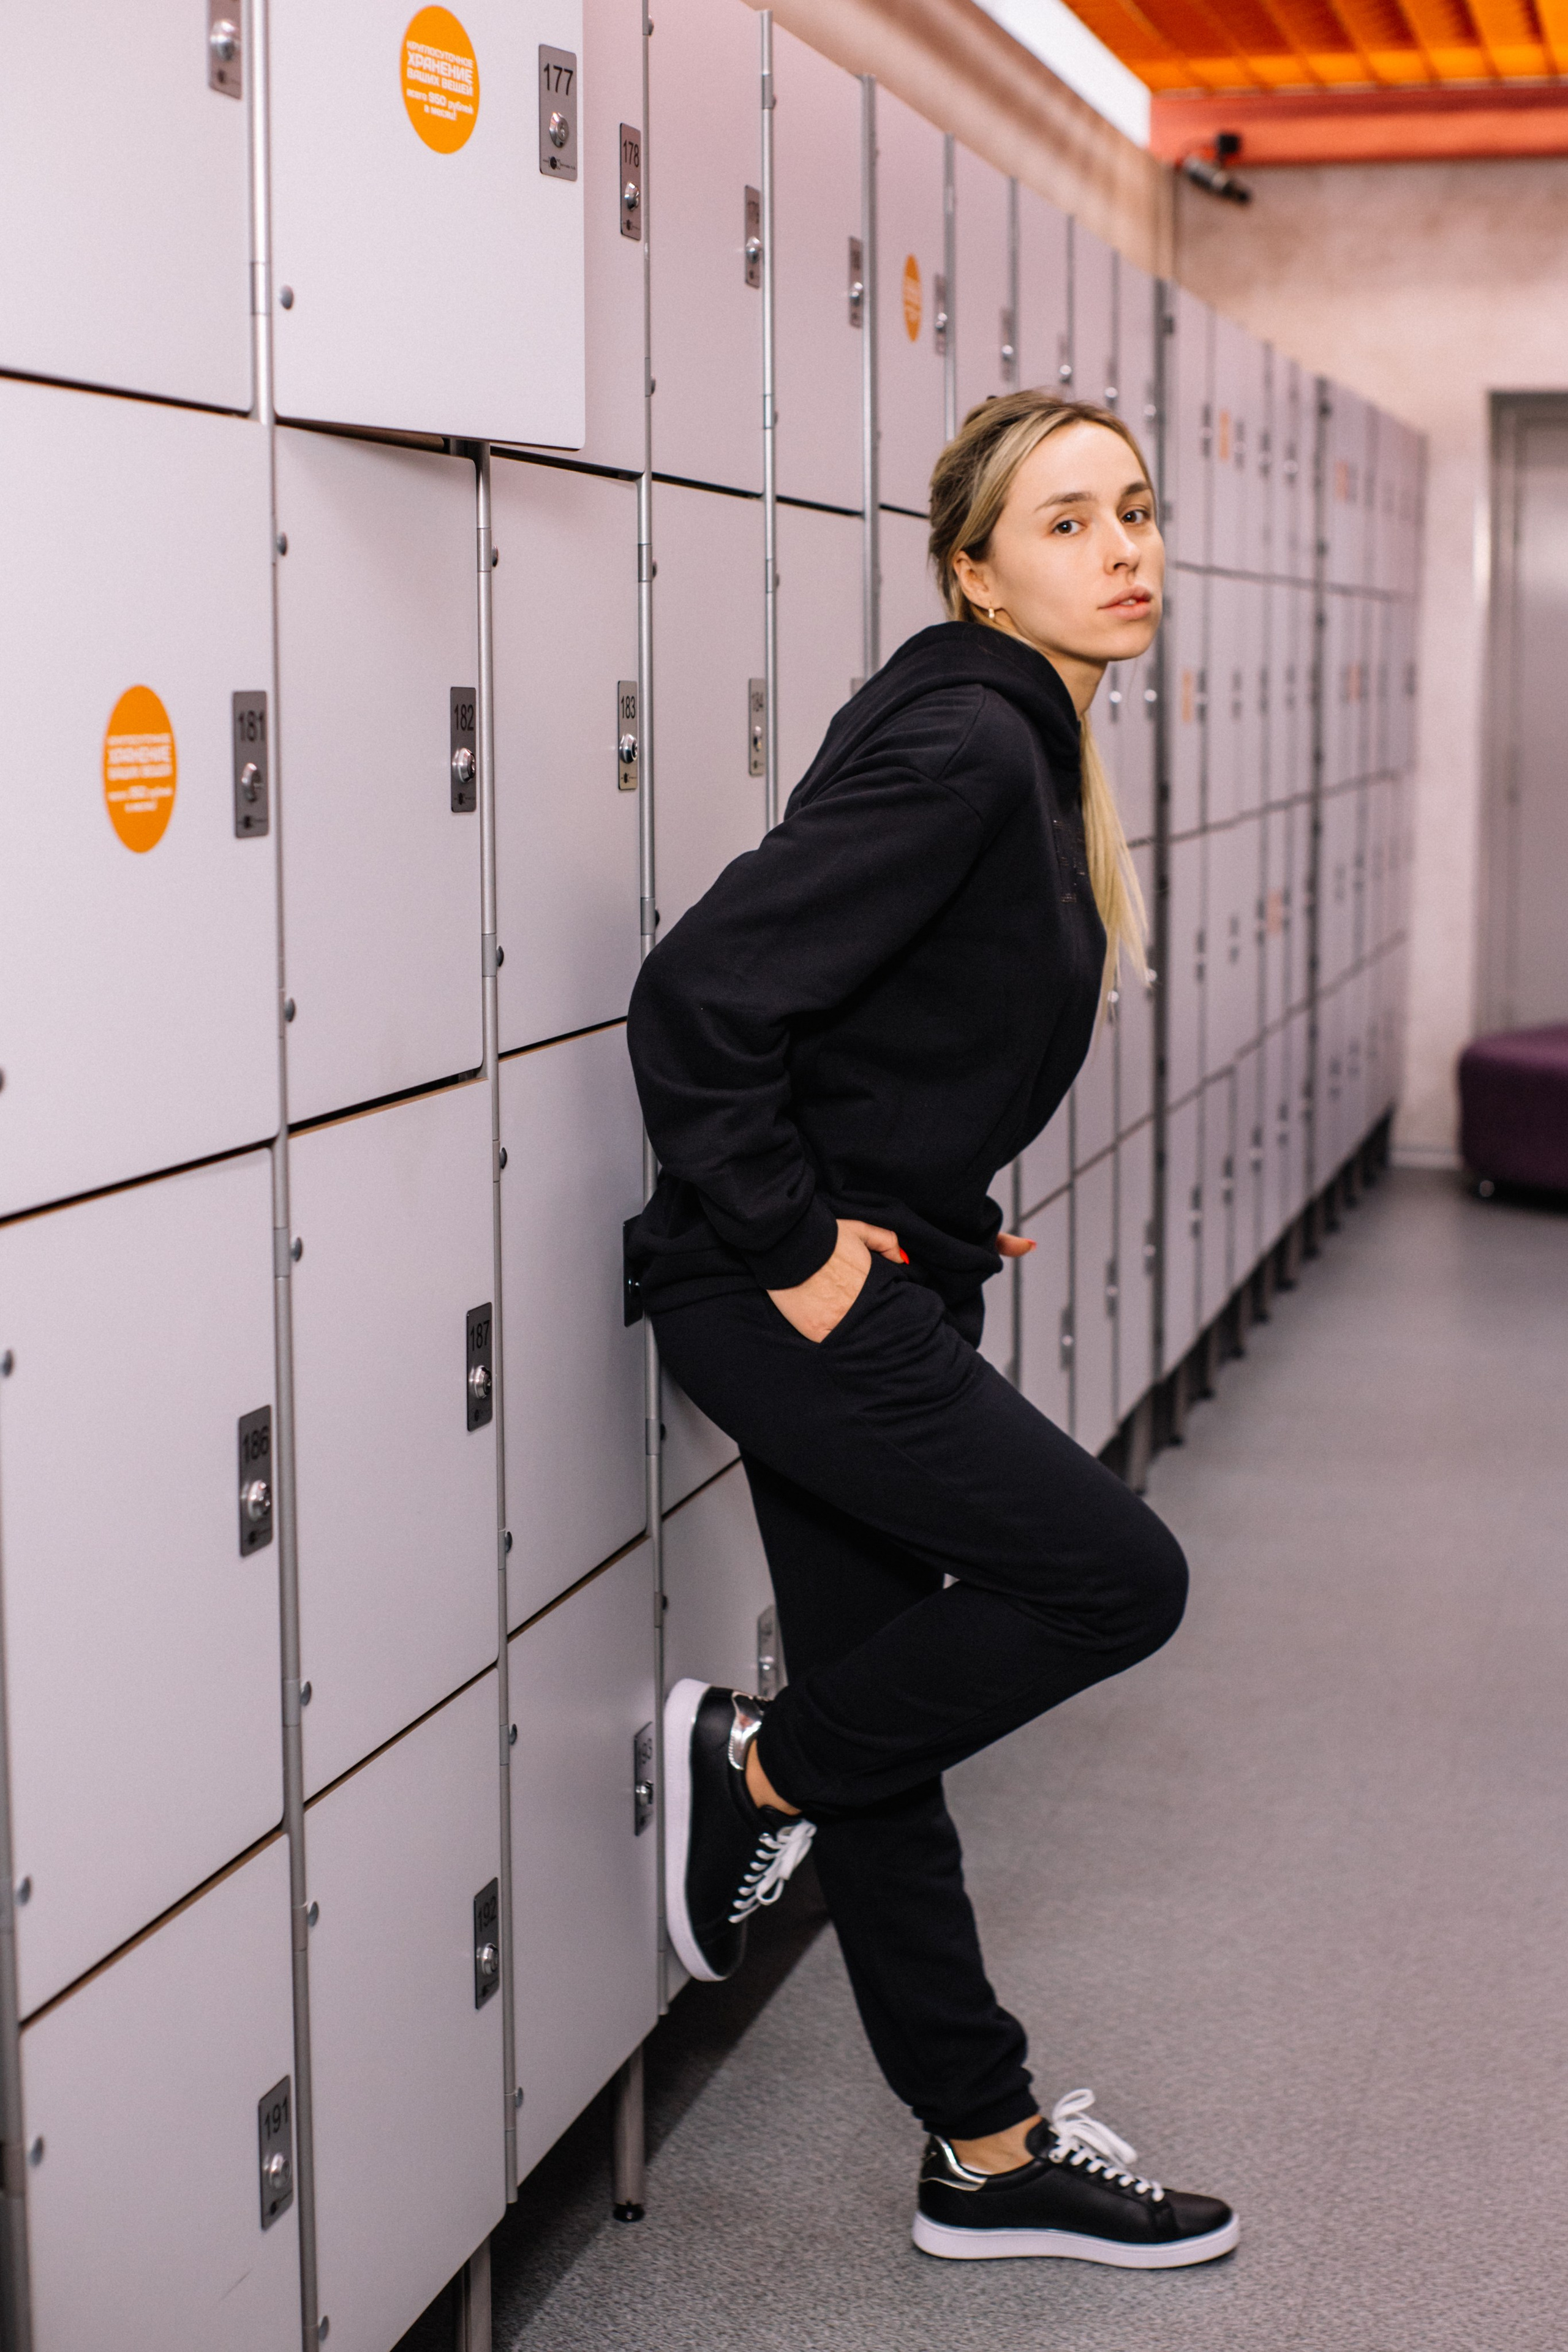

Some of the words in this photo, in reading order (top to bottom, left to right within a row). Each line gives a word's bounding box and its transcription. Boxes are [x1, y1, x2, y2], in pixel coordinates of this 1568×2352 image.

[406, 67, 440, 86] ВАШИХ
[441, 77, 473, 96] ВЕЩЕЙ
[407, 50, 473, 85] ХРАНЕНИЕ
[543, 63, 573, 96] 177
[624, 140, 639, 167] 178
[454, 704, 474, 731] 182
[621, 696, 636, 718] 183
[239, 710, 265, 742] 181
[470, 1319, 490, 1351] 187
[243, 1425, 270, 1463] 186
[478, 1896, 497, 1931] 192
[265, 2095, 288, 2141] 191
